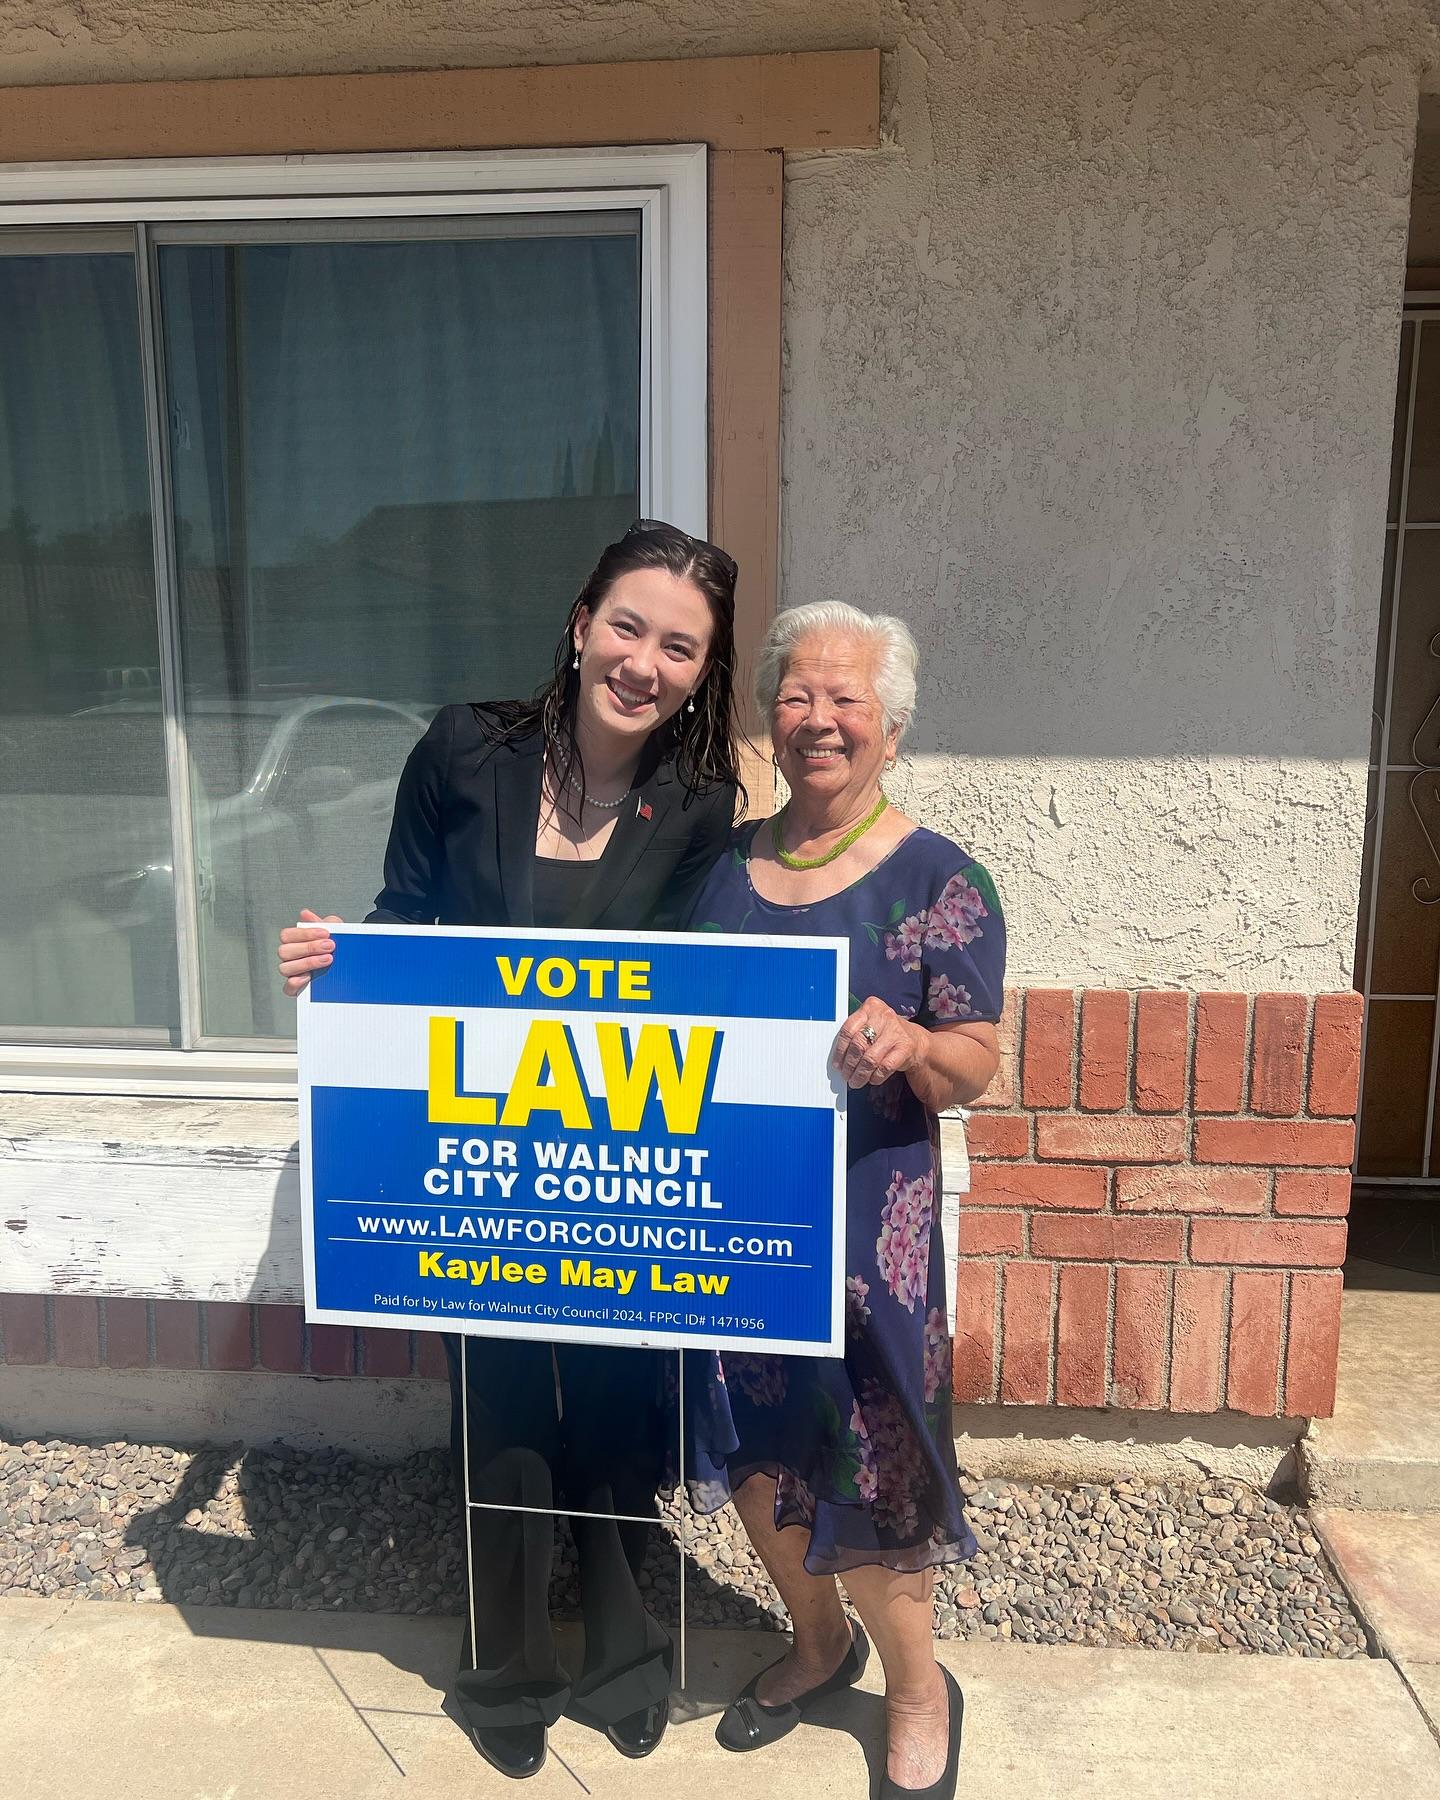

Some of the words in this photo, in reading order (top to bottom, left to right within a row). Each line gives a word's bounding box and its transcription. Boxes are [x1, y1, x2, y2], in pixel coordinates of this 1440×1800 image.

[497, 956, 651, 1001] VOTE
[428, 1016, 724, 1135] LAW
[438, 1138, 518, 1167] FOR
[533, 1142, 709, 1176] WALNUT
[424, 1169, 519, 1198] CITY
[534, 1174, 723, 1209] COUNCIL
[357, 1213, 793, 1257] www.LAWFORCOUNCIL.com
[420, 1252, 547, 1286] Kaylee
[562, 1259, 637, 1295] May
[652, 1264, 730, 1295] Law
[374, 1293, 400, 1306] Paid
[402, 1295, 420, 1307] for
[422, 1296, 438, 1311] by
[441, 1298, 466, 1310] Law
[468, 1299, 486, 1312] for
[487, 1301, 532, 1315] Walnut
[534, 1304, 559, 1319] City
[561, 1305, 609, 1320] Council
[613, 1310, 647, 1322] 2024.
[649, 1311, 682, 1325] FPPC
[685, 1313, 706, 1326] ID#
[710, 1315, 765, 1330] 1471956
